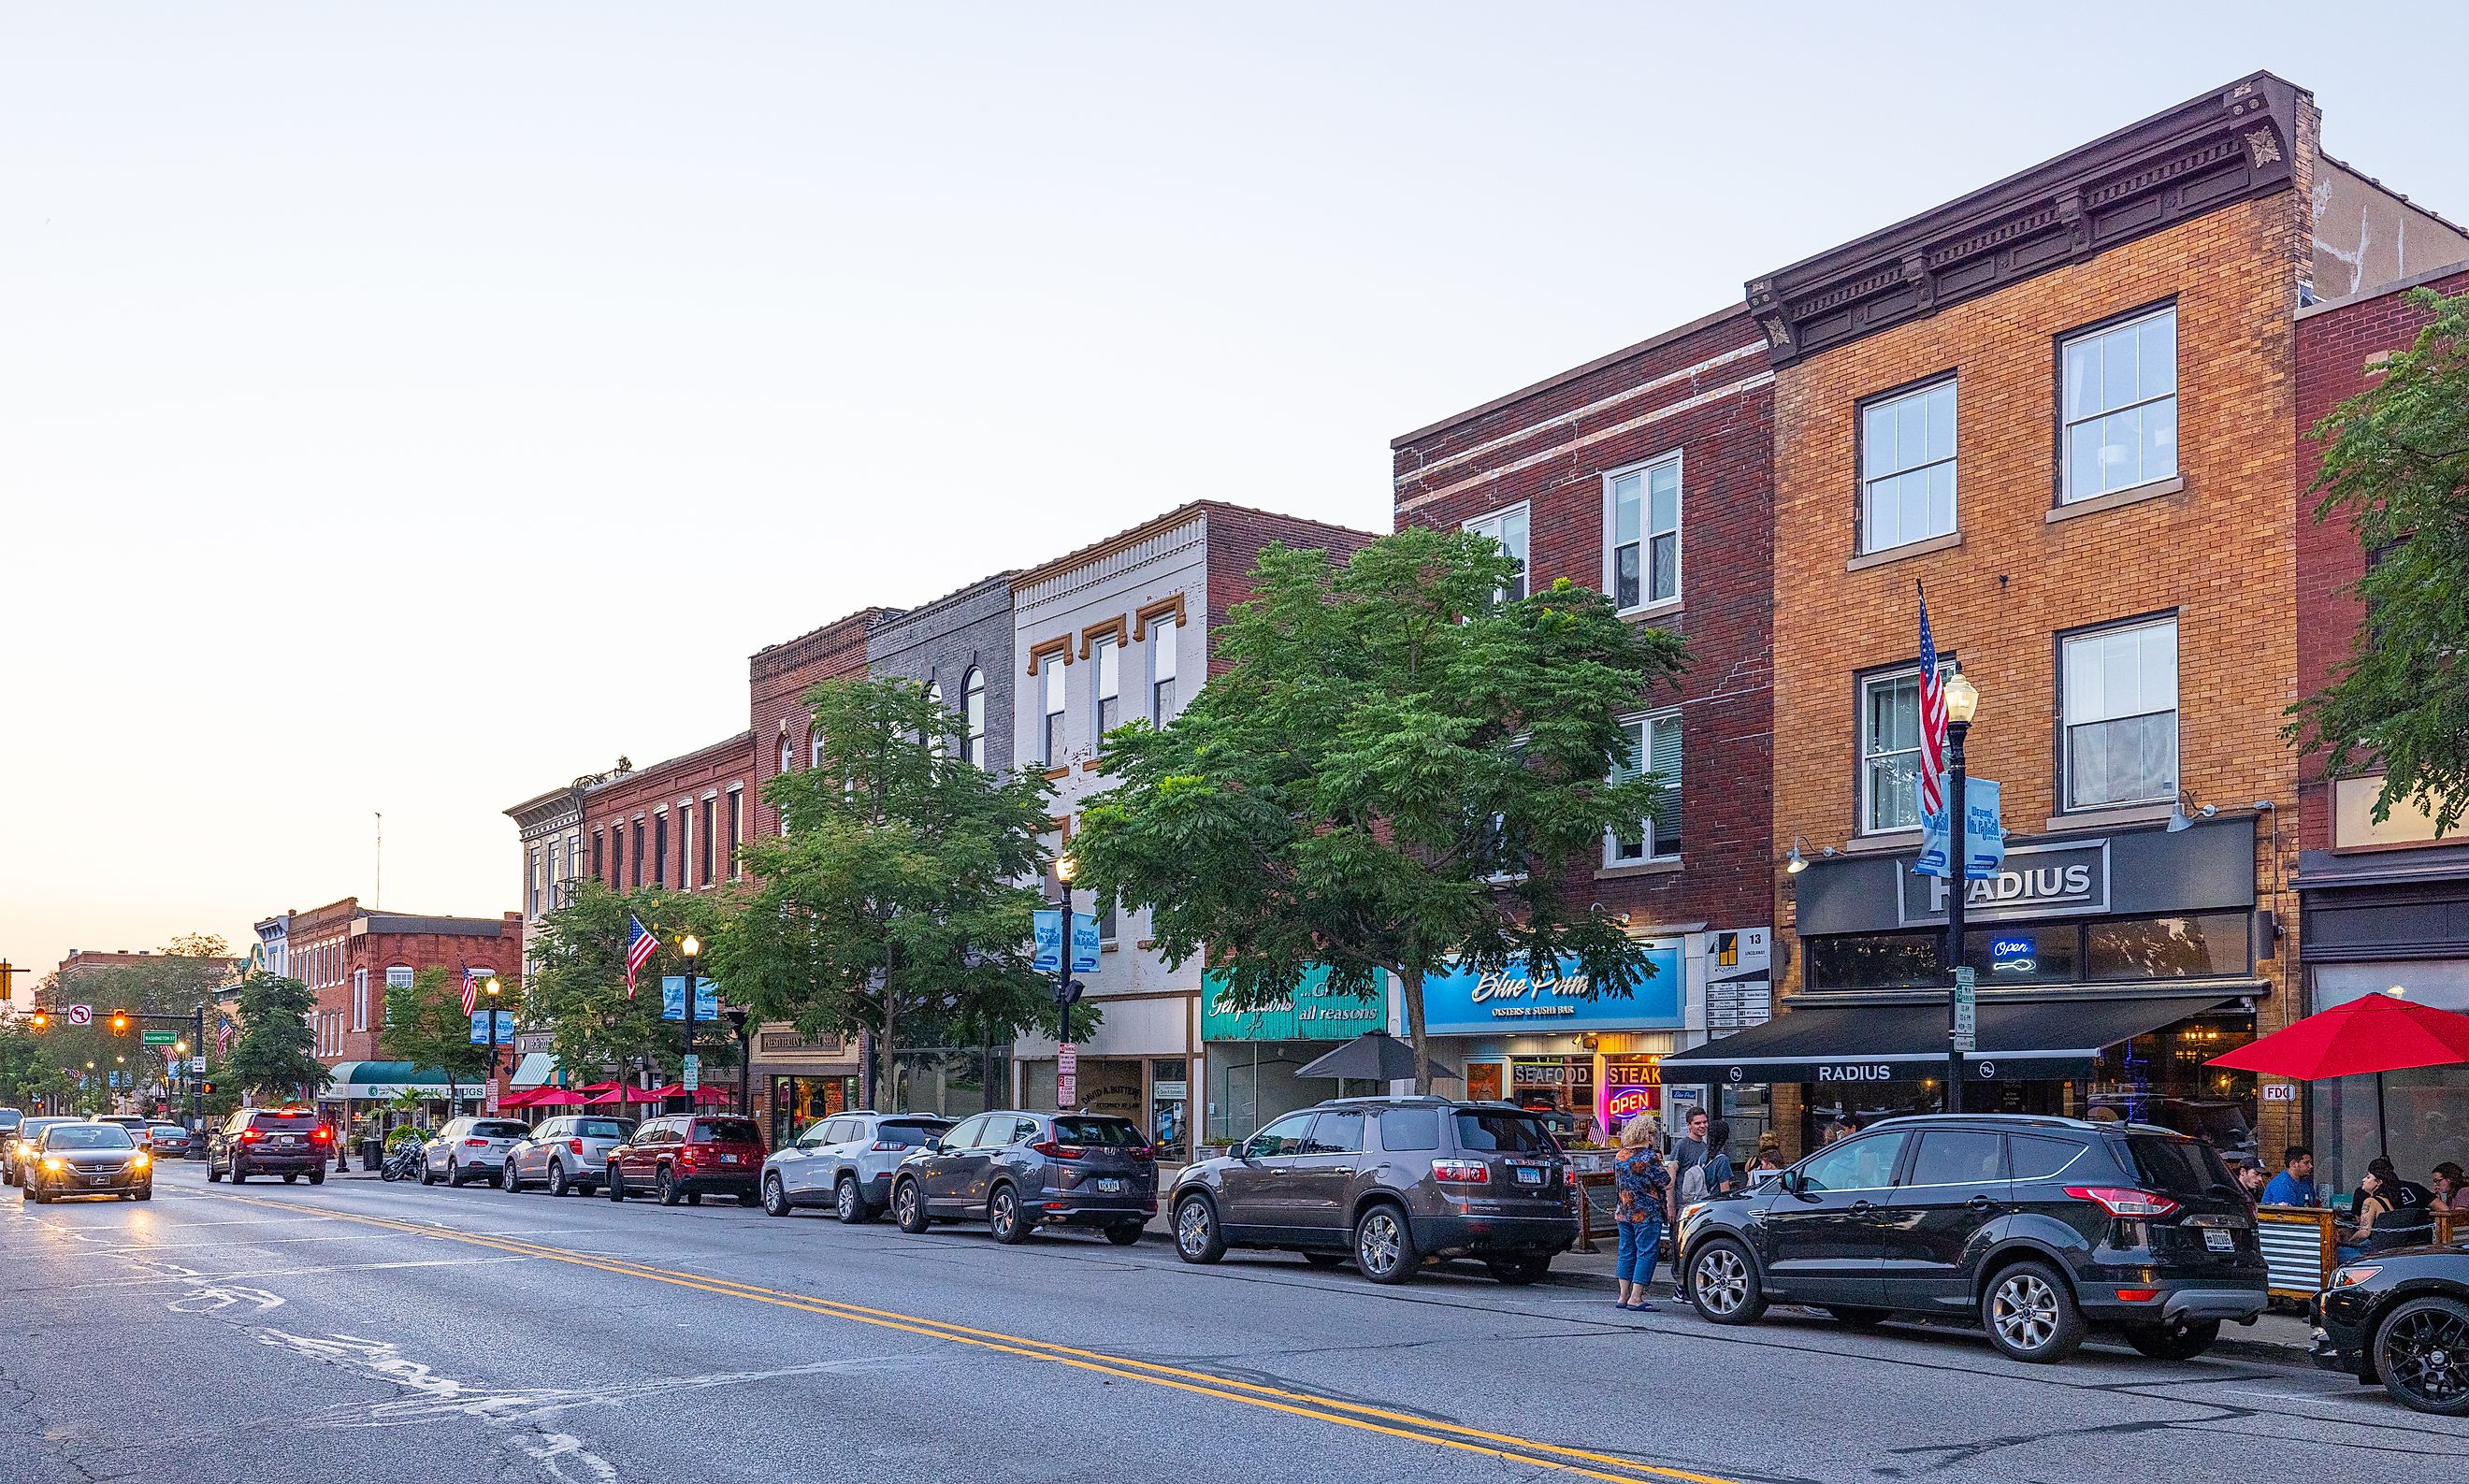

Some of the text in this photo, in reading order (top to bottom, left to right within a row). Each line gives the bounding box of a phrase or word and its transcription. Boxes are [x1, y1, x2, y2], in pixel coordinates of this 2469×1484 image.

[1749, 934, 1761, 944] 13
[1994, 941, 2029, 956] Open
[1472, 971, 1528, 1002] Blue
[1299, 1005, 1378, 1020] all reasons
[1525, 1007, 1531, 1016] &
[1534, 1006, 1556, 1015] SUSHI
[1558, 1005, 1574, 1014] BAR
[1515, 1068, 1588, 1083] SEAFOOD
[1819, 1065, 1891, 1081] RADIUS
[445, 1088, 484, 1096] DUGS
[1081, 1088, 1103, 1104] DAVID
[1610, 1092, 1650, 1116] OPEN
